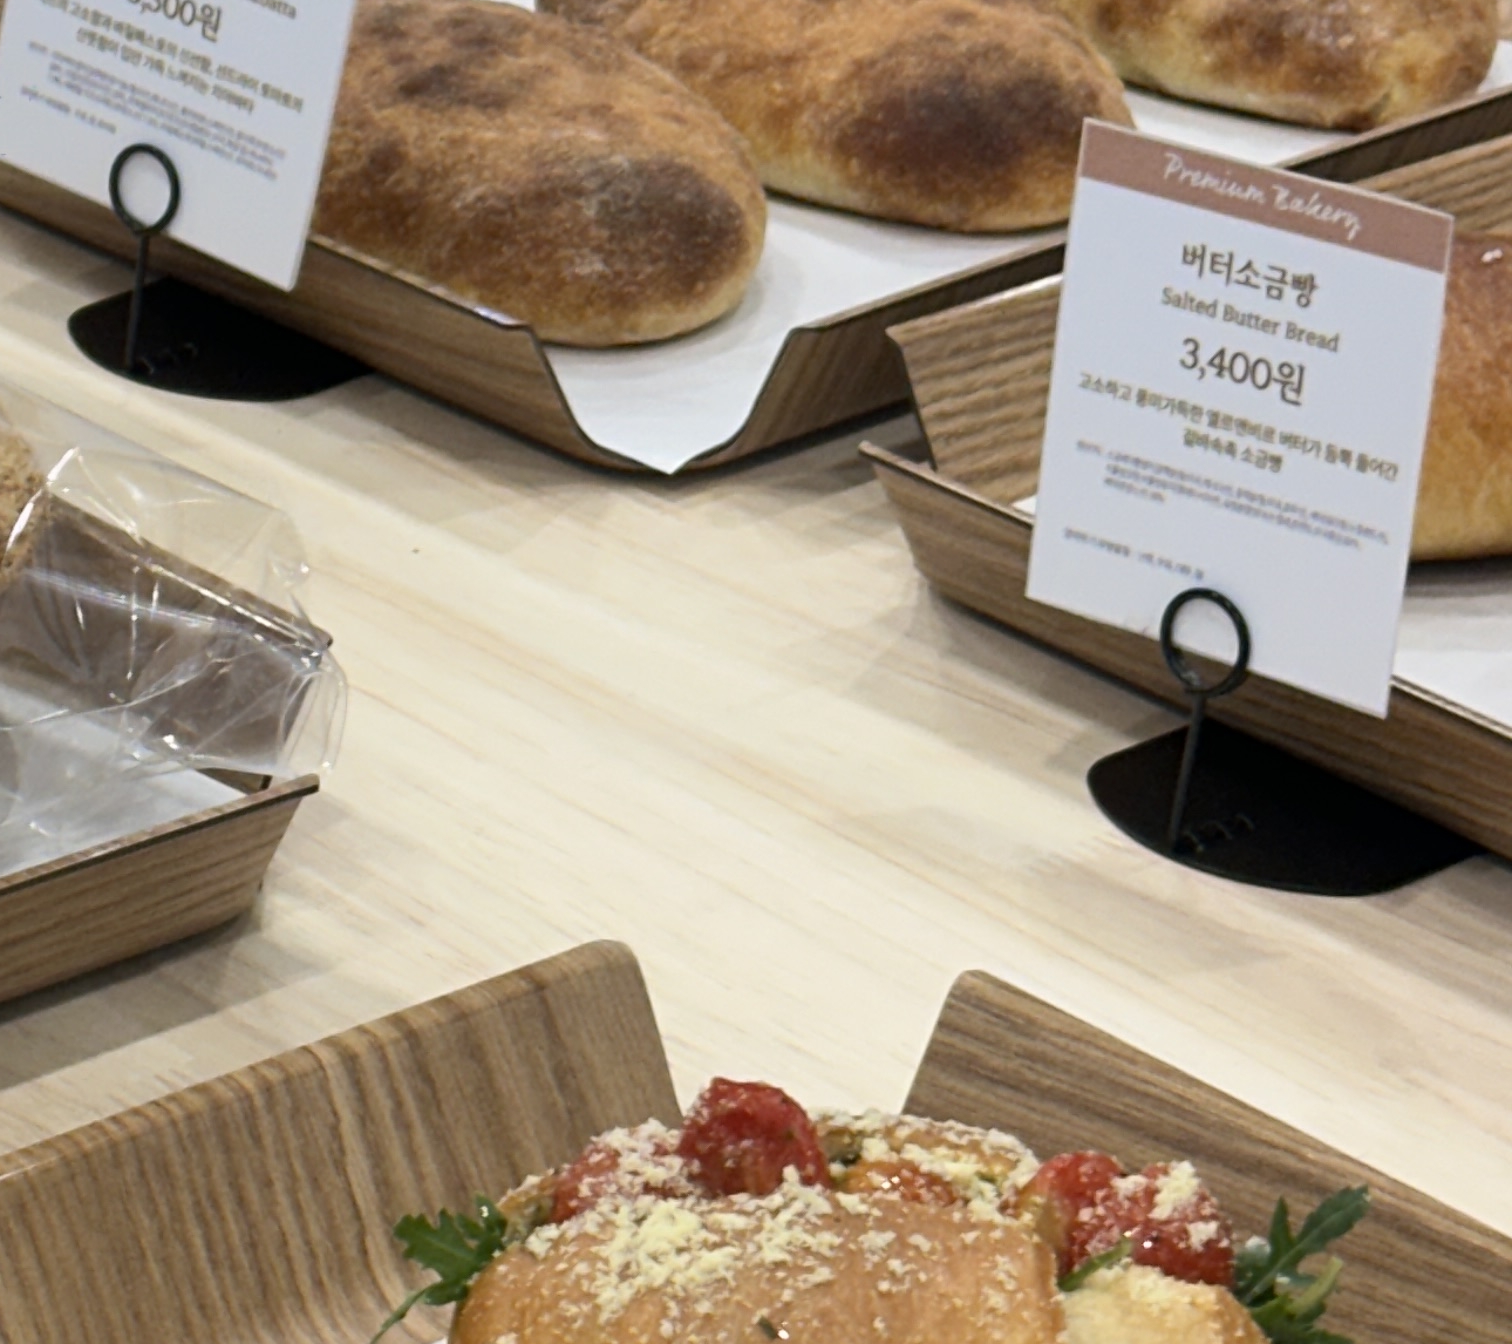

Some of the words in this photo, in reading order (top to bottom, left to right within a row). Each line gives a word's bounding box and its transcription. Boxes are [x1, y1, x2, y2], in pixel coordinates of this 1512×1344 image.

[1163, 152, 1265, 204] Premium
[1272, 184, 1361, 241] Bakery
[1181, 243, 1319, 309] 버터소금빵
[1161, 286, 1219, 319] Salted
[1222, 303, 1281, 336] Butter
[1284, 320, 1341, 354] Bread
[1179, 337, 1306, 407] 3,400원
[1078, 372, 1133, 402] 고소하고
[1278, 431, 1322, 458] 버터가
[1324, 443, 1353, 468] 듬뿍
[1355, 452, 1399, 482] 들어간
[1241, 447, 1283, 474] 소금빵
